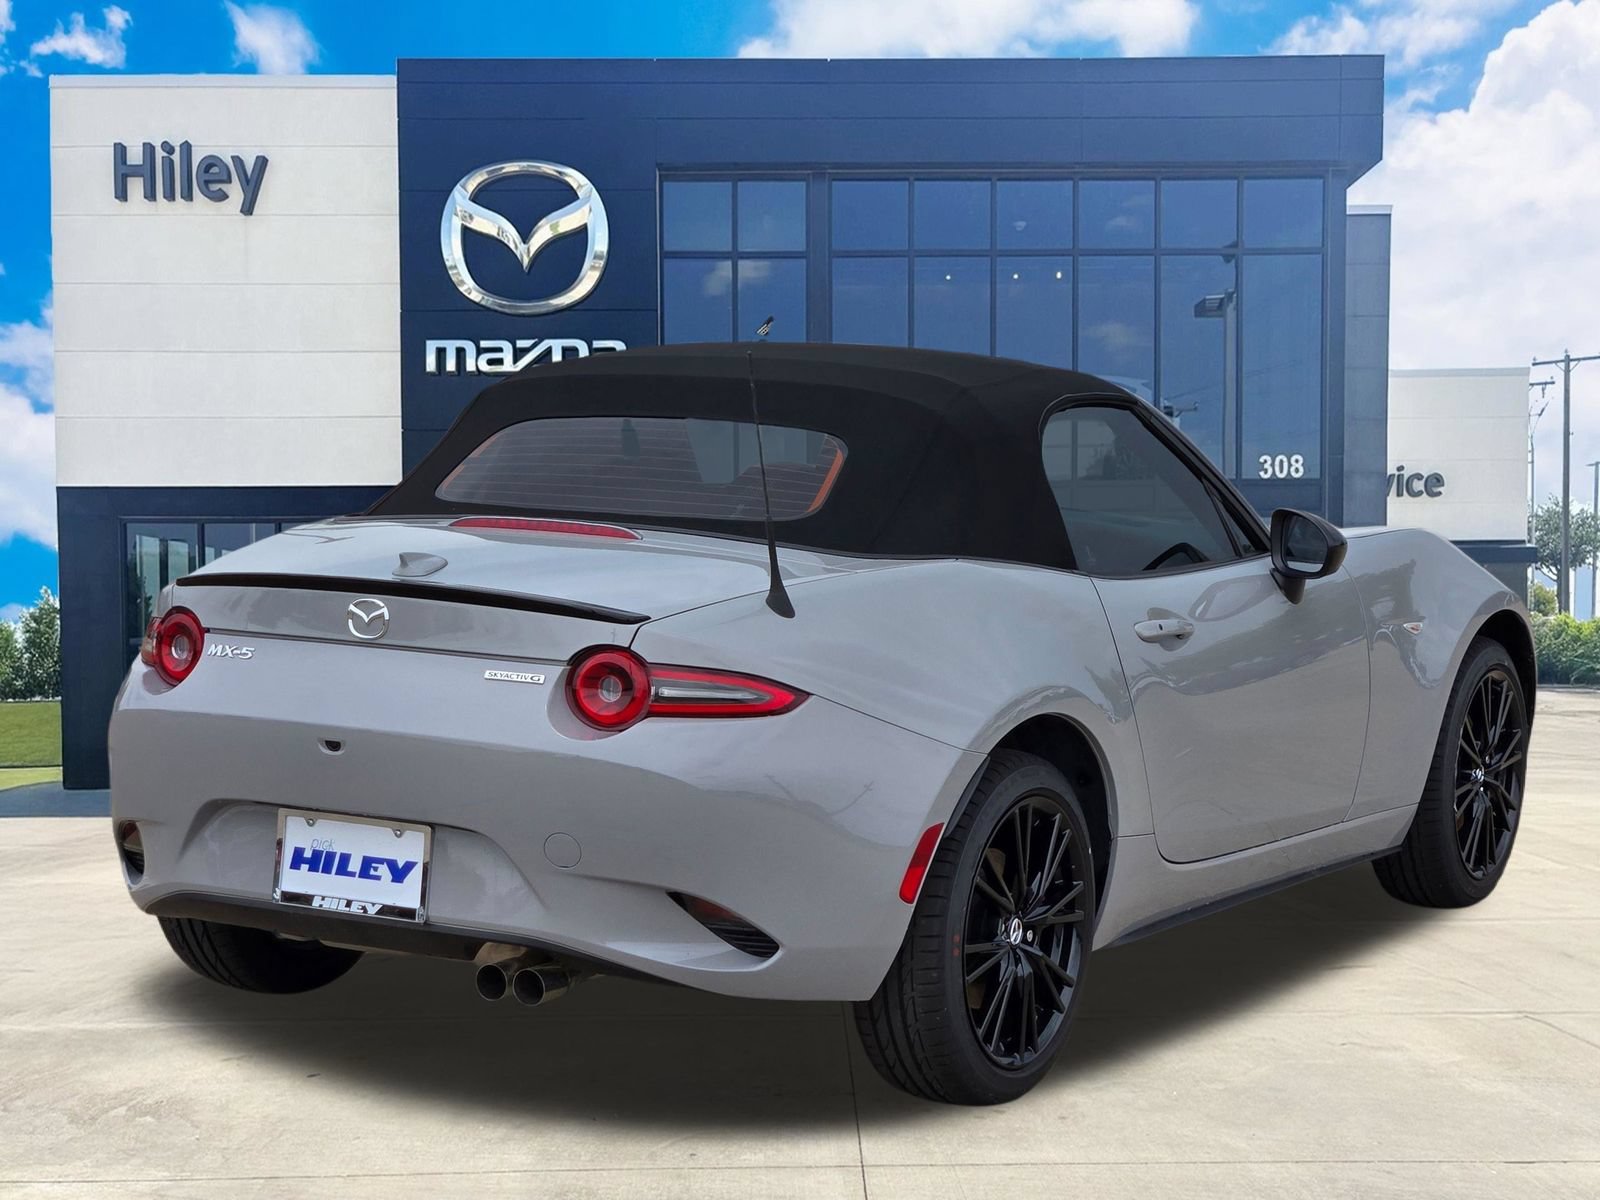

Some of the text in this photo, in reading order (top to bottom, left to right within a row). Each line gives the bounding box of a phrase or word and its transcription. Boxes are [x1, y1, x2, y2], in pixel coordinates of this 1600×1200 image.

[113, 140, 269, 216] Hiley
[1258, 454, 1304, 479] 308
[207, 644, 255, 659] MX-5
[289, 846, 419, 884] HILEY
[311, 895, 384, 915] HILEY
